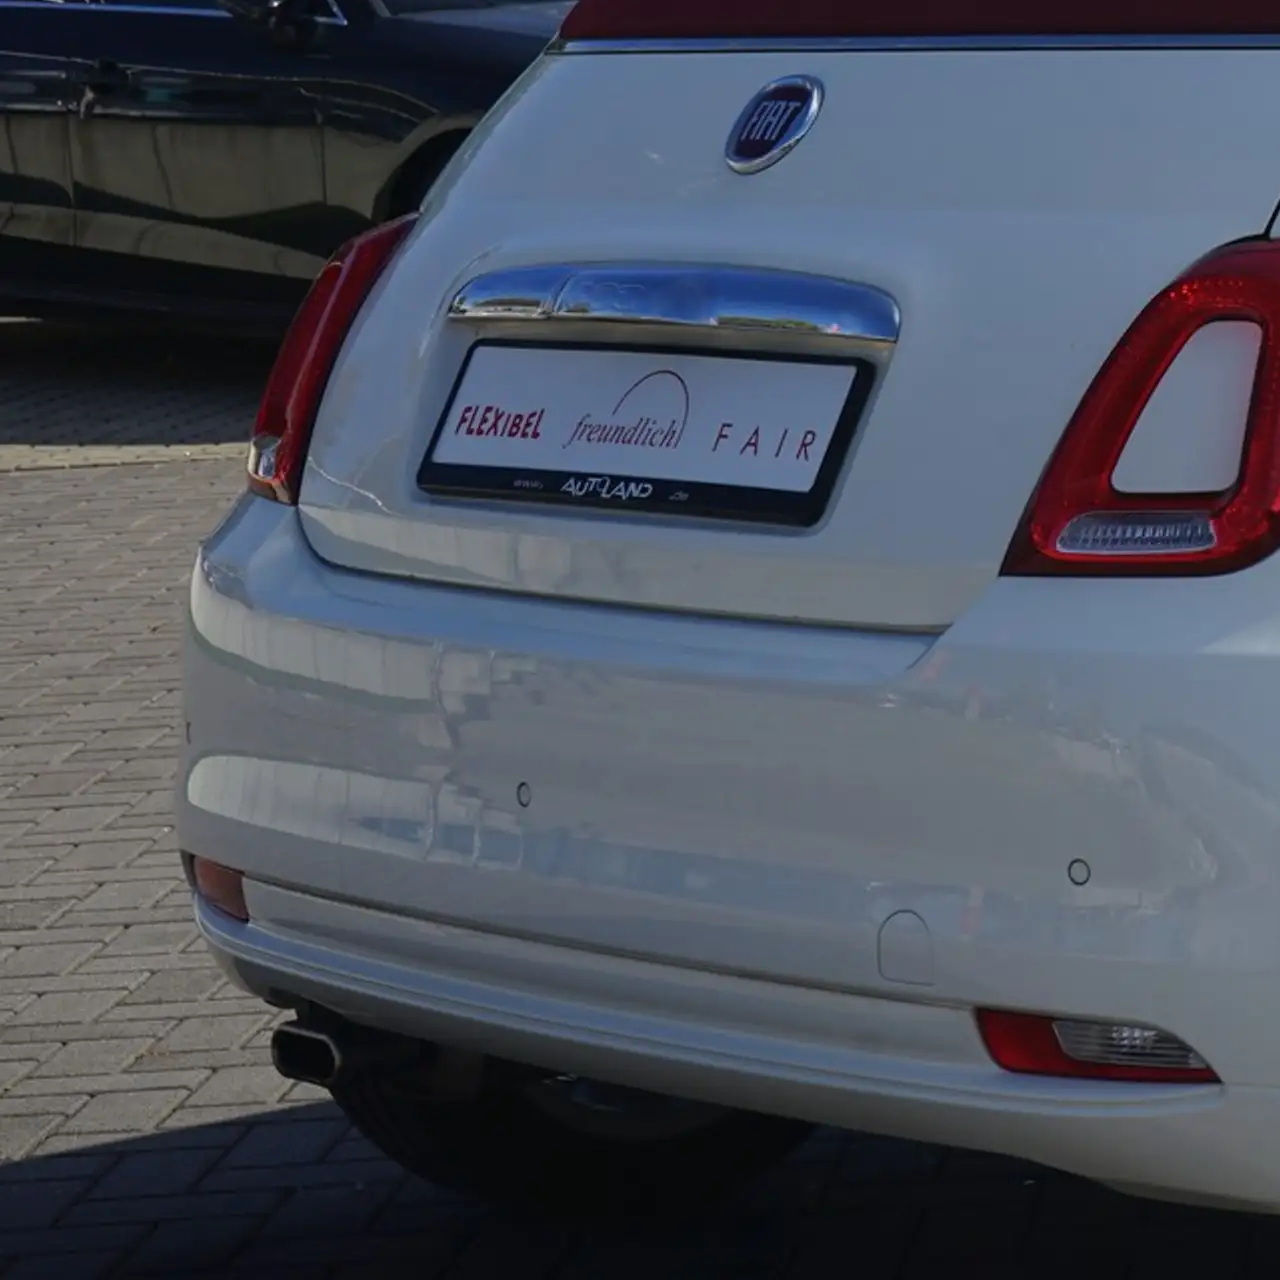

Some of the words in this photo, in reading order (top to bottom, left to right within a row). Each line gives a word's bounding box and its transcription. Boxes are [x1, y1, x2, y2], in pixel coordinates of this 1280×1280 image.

[741, 99, 801, 141] FIAT
[454, 405, 545, 440] FLEXIBEL
[712, 422, 817, 462] FAIR
[560, 476, 653, 501] AUTOLAND
